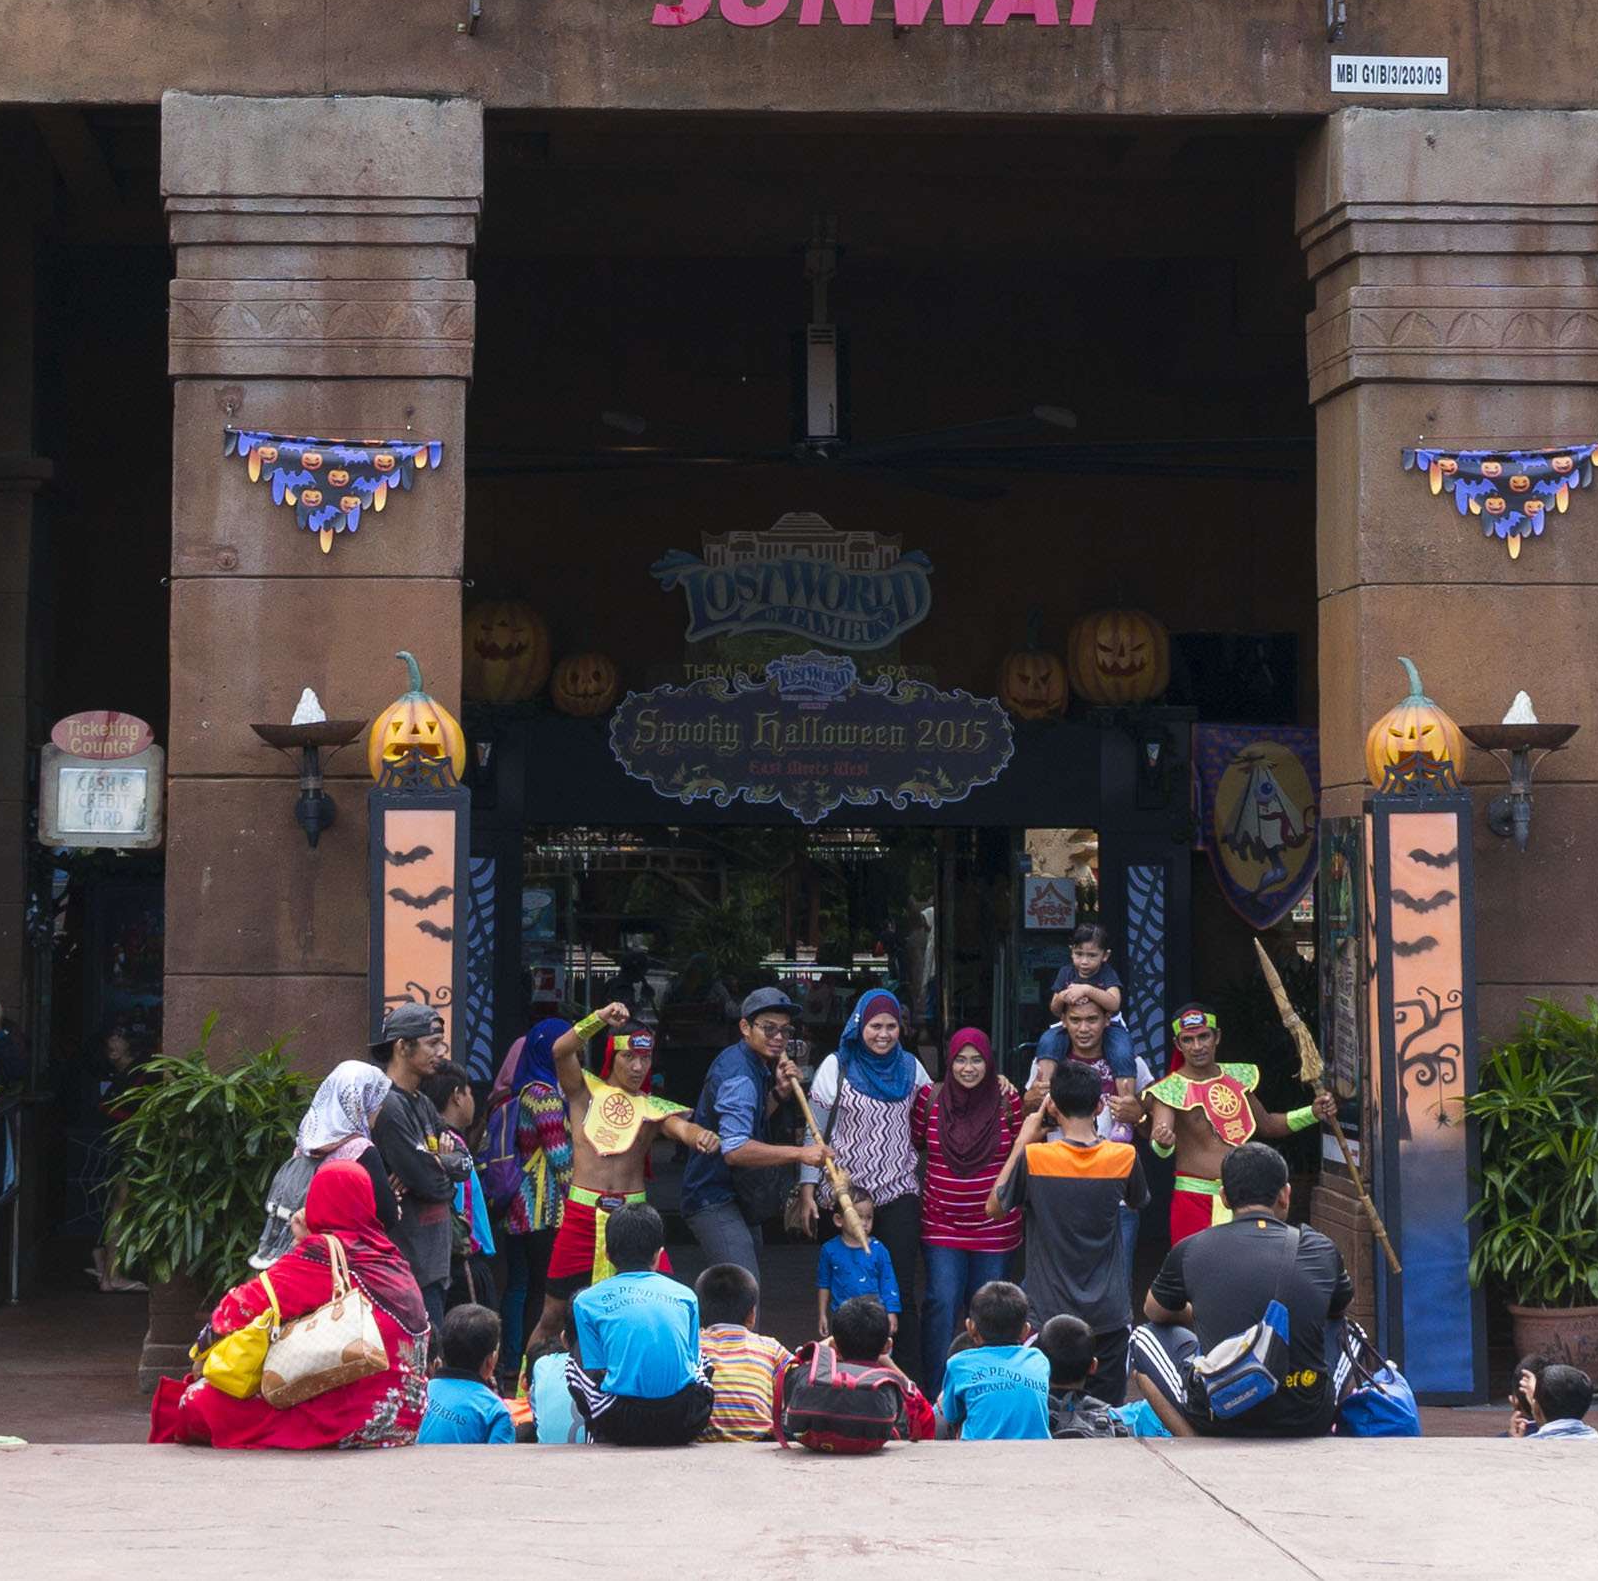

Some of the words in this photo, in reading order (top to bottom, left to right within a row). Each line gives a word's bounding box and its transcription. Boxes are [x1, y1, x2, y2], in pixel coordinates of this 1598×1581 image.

[1336, 63, 1358, 84] MBI
[1362, 64, 1443, 86] G1/B/3/203/09
[66, 720, 140, 740] Ticketing
[633, 708, 740, 754] Spooky
[754, 709, 907, 753] Halloween
[915, 718, 990, 752] 2015
[70, 738, 138, 754] Counter
[989, 1366, 1021, 1382] PEND
